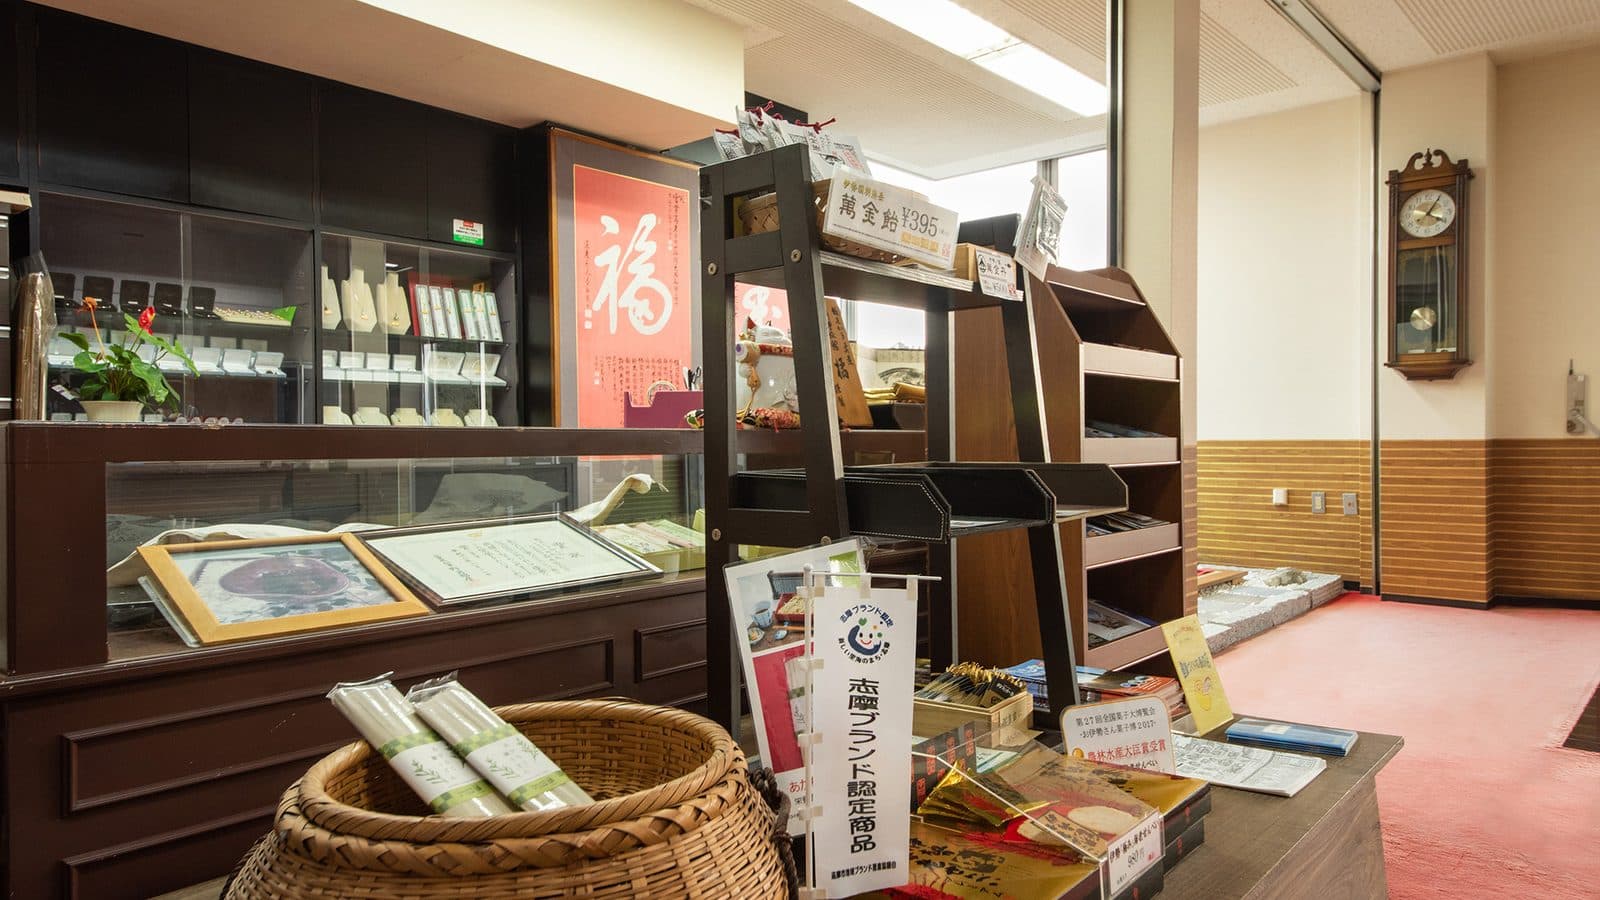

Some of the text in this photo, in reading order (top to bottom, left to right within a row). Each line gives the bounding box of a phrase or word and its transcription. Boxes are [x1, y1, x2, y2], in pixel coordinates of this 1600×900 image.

[839, 192, 939, 238] 萬金飴 ¥395
[592, 213, 673, 336] 福
[1075, 706, 1156, 727] 第27回全国菓子大博覧会
[847, 678, 880, 854] 志摩ブランド認定商品
